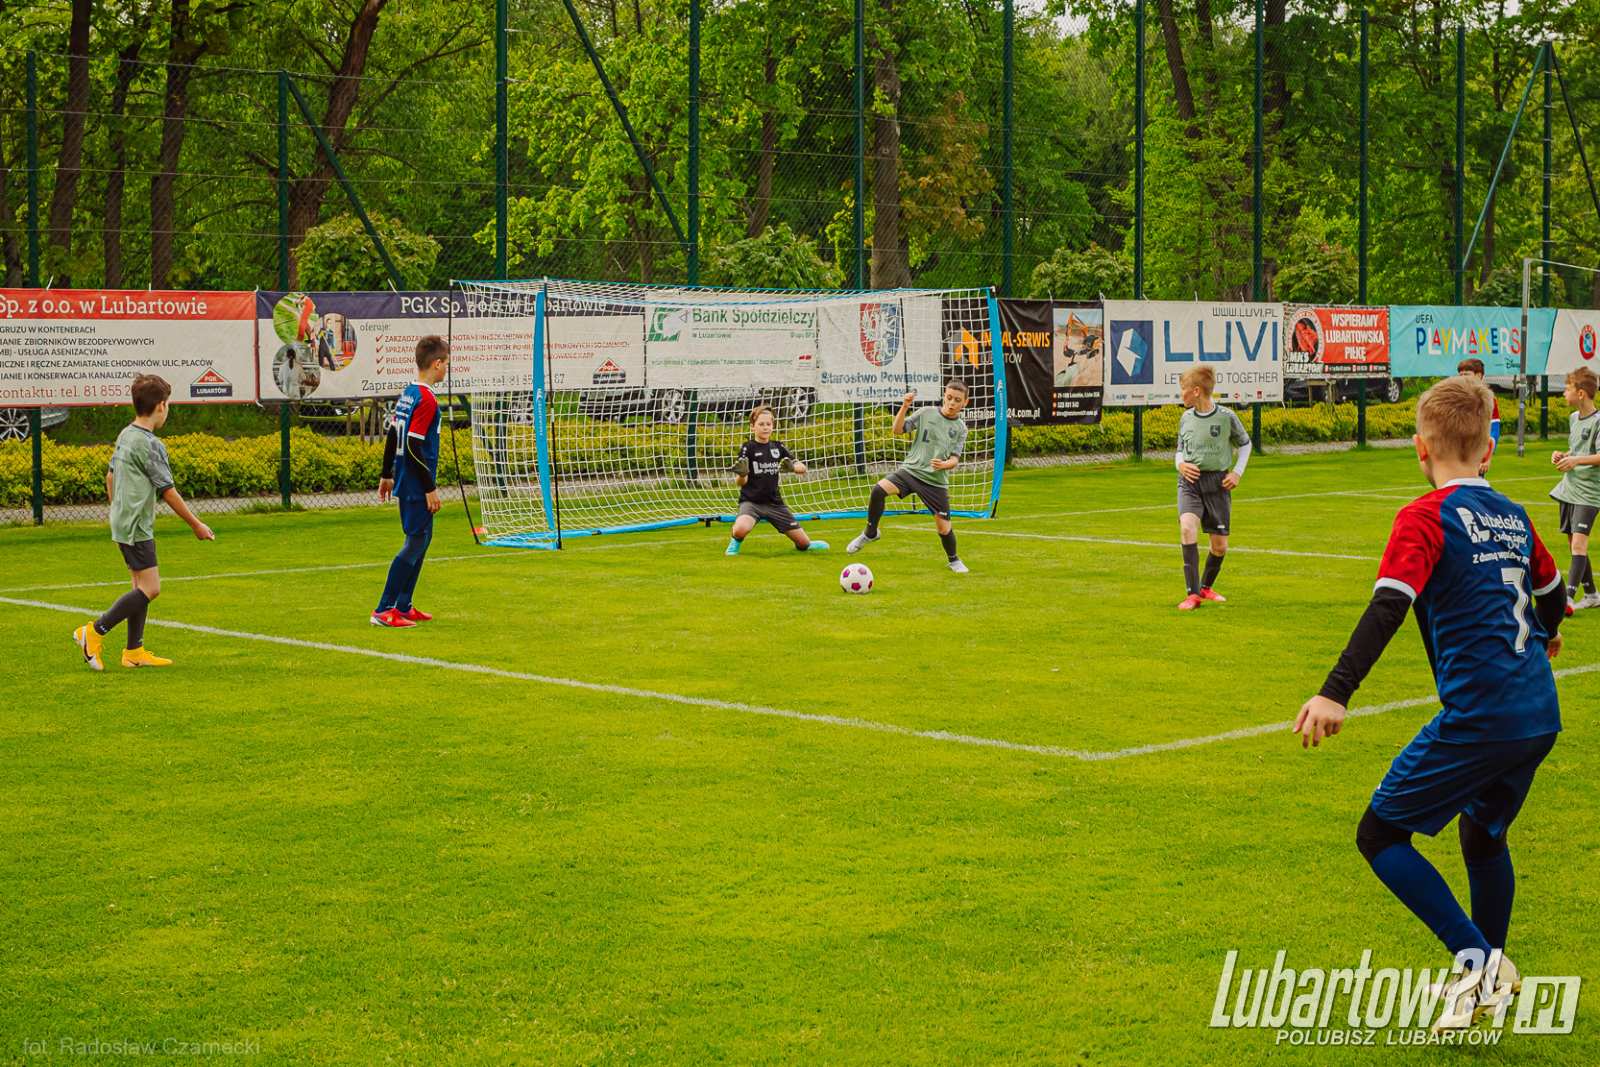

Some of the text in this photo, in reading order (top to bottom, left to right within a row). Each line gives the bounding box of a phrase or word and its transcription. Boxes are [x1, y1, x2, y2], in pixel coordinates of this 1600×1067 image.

[28, 299, 38, 313] z
[42, 299, 75, 313] o.o.
[79, 300, 96, 313] w
[100, 295, 208, 315] Lubartowie
[400, 296, 438, 314] PGK
[440, 296, 464, 318] Sp.
[523, 298, 606, 313] Lbartowie
[692, 308, 816, 328] Bank Spółdzielczy
[1212, 306, 1278, 318] WWW.LUVI.PL
[1331, 313, 1379, 327] WSPIERAMY
[1415, 314, 1434, 324] UEFA
[0, 325, 96, 334] GRUZU W KONTENERACH
[25, 337, 77, 346] ZBIORNIKÓW
[78, 336, 155, 346] BEZODPŁYWOWYCH
[1163, 320, 1278, 362] LUVI
[1416, 327, 1521, 355] PLAYMAKERS
[18, 348, 50, 356] USŁUGA
[51, 347, 108, 356] ASENIZACYJNA
[30, 360, 61, 370] RĘCZNE
[62, 360, 110, 368] ZAMIATANIE
[181, 358, 213, 368] PLACÓW
[27, 371, 87, 380] KONSERWACJA
[821, 371, 877, 384] Starostwo
[1226, 371, 1279, 384] TOGETHER
[83, 385, 97, 397] 81
[100, 384, 122, 397] 855
[856, 386, 918, 399] Lubartowe
[1500, 567, 1530, 654] 7
